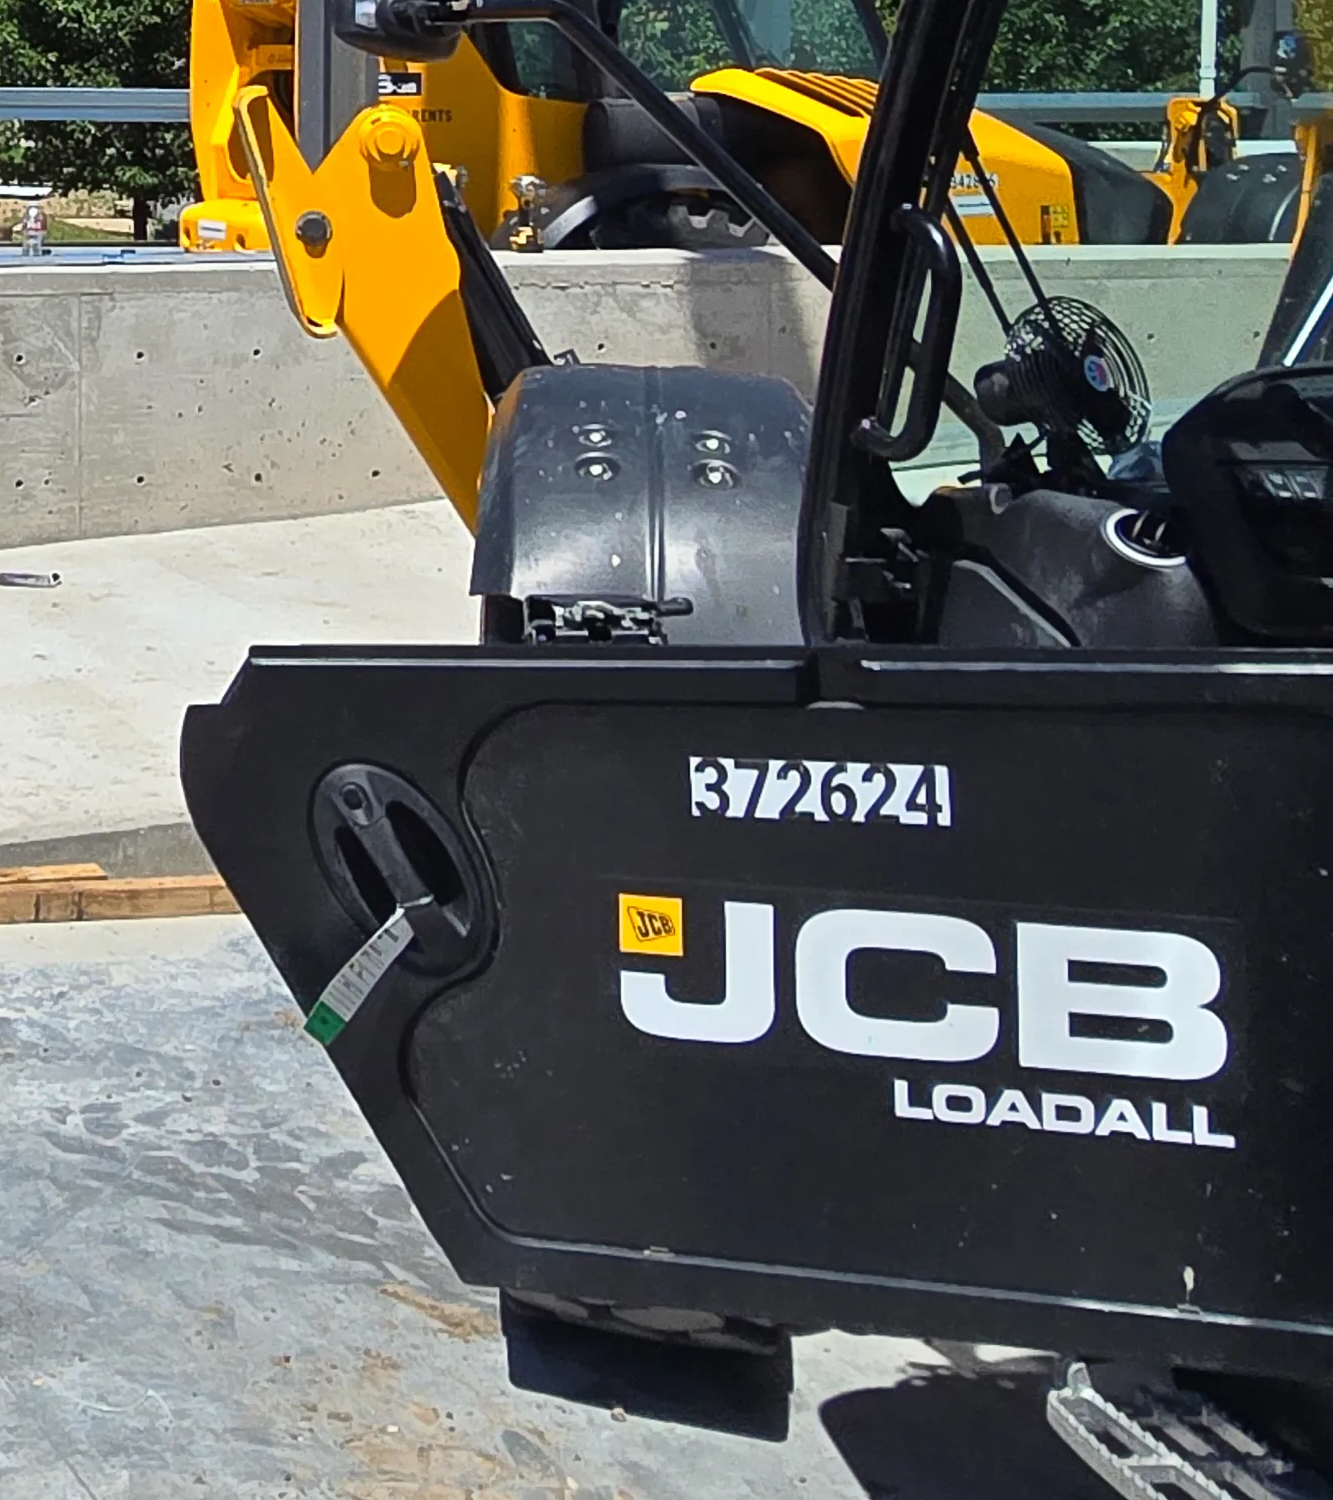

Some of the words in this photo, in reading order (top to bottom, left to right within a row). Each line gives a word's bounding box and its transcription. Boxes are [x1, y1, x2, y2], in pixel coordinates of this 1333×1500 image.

[693, 757, 945, 826] 372624
[636, 910, 673, 938] JCB
[620, 900, 1229, 1080] JCB
[894, 1078, 1236, 1149] LOADALL
